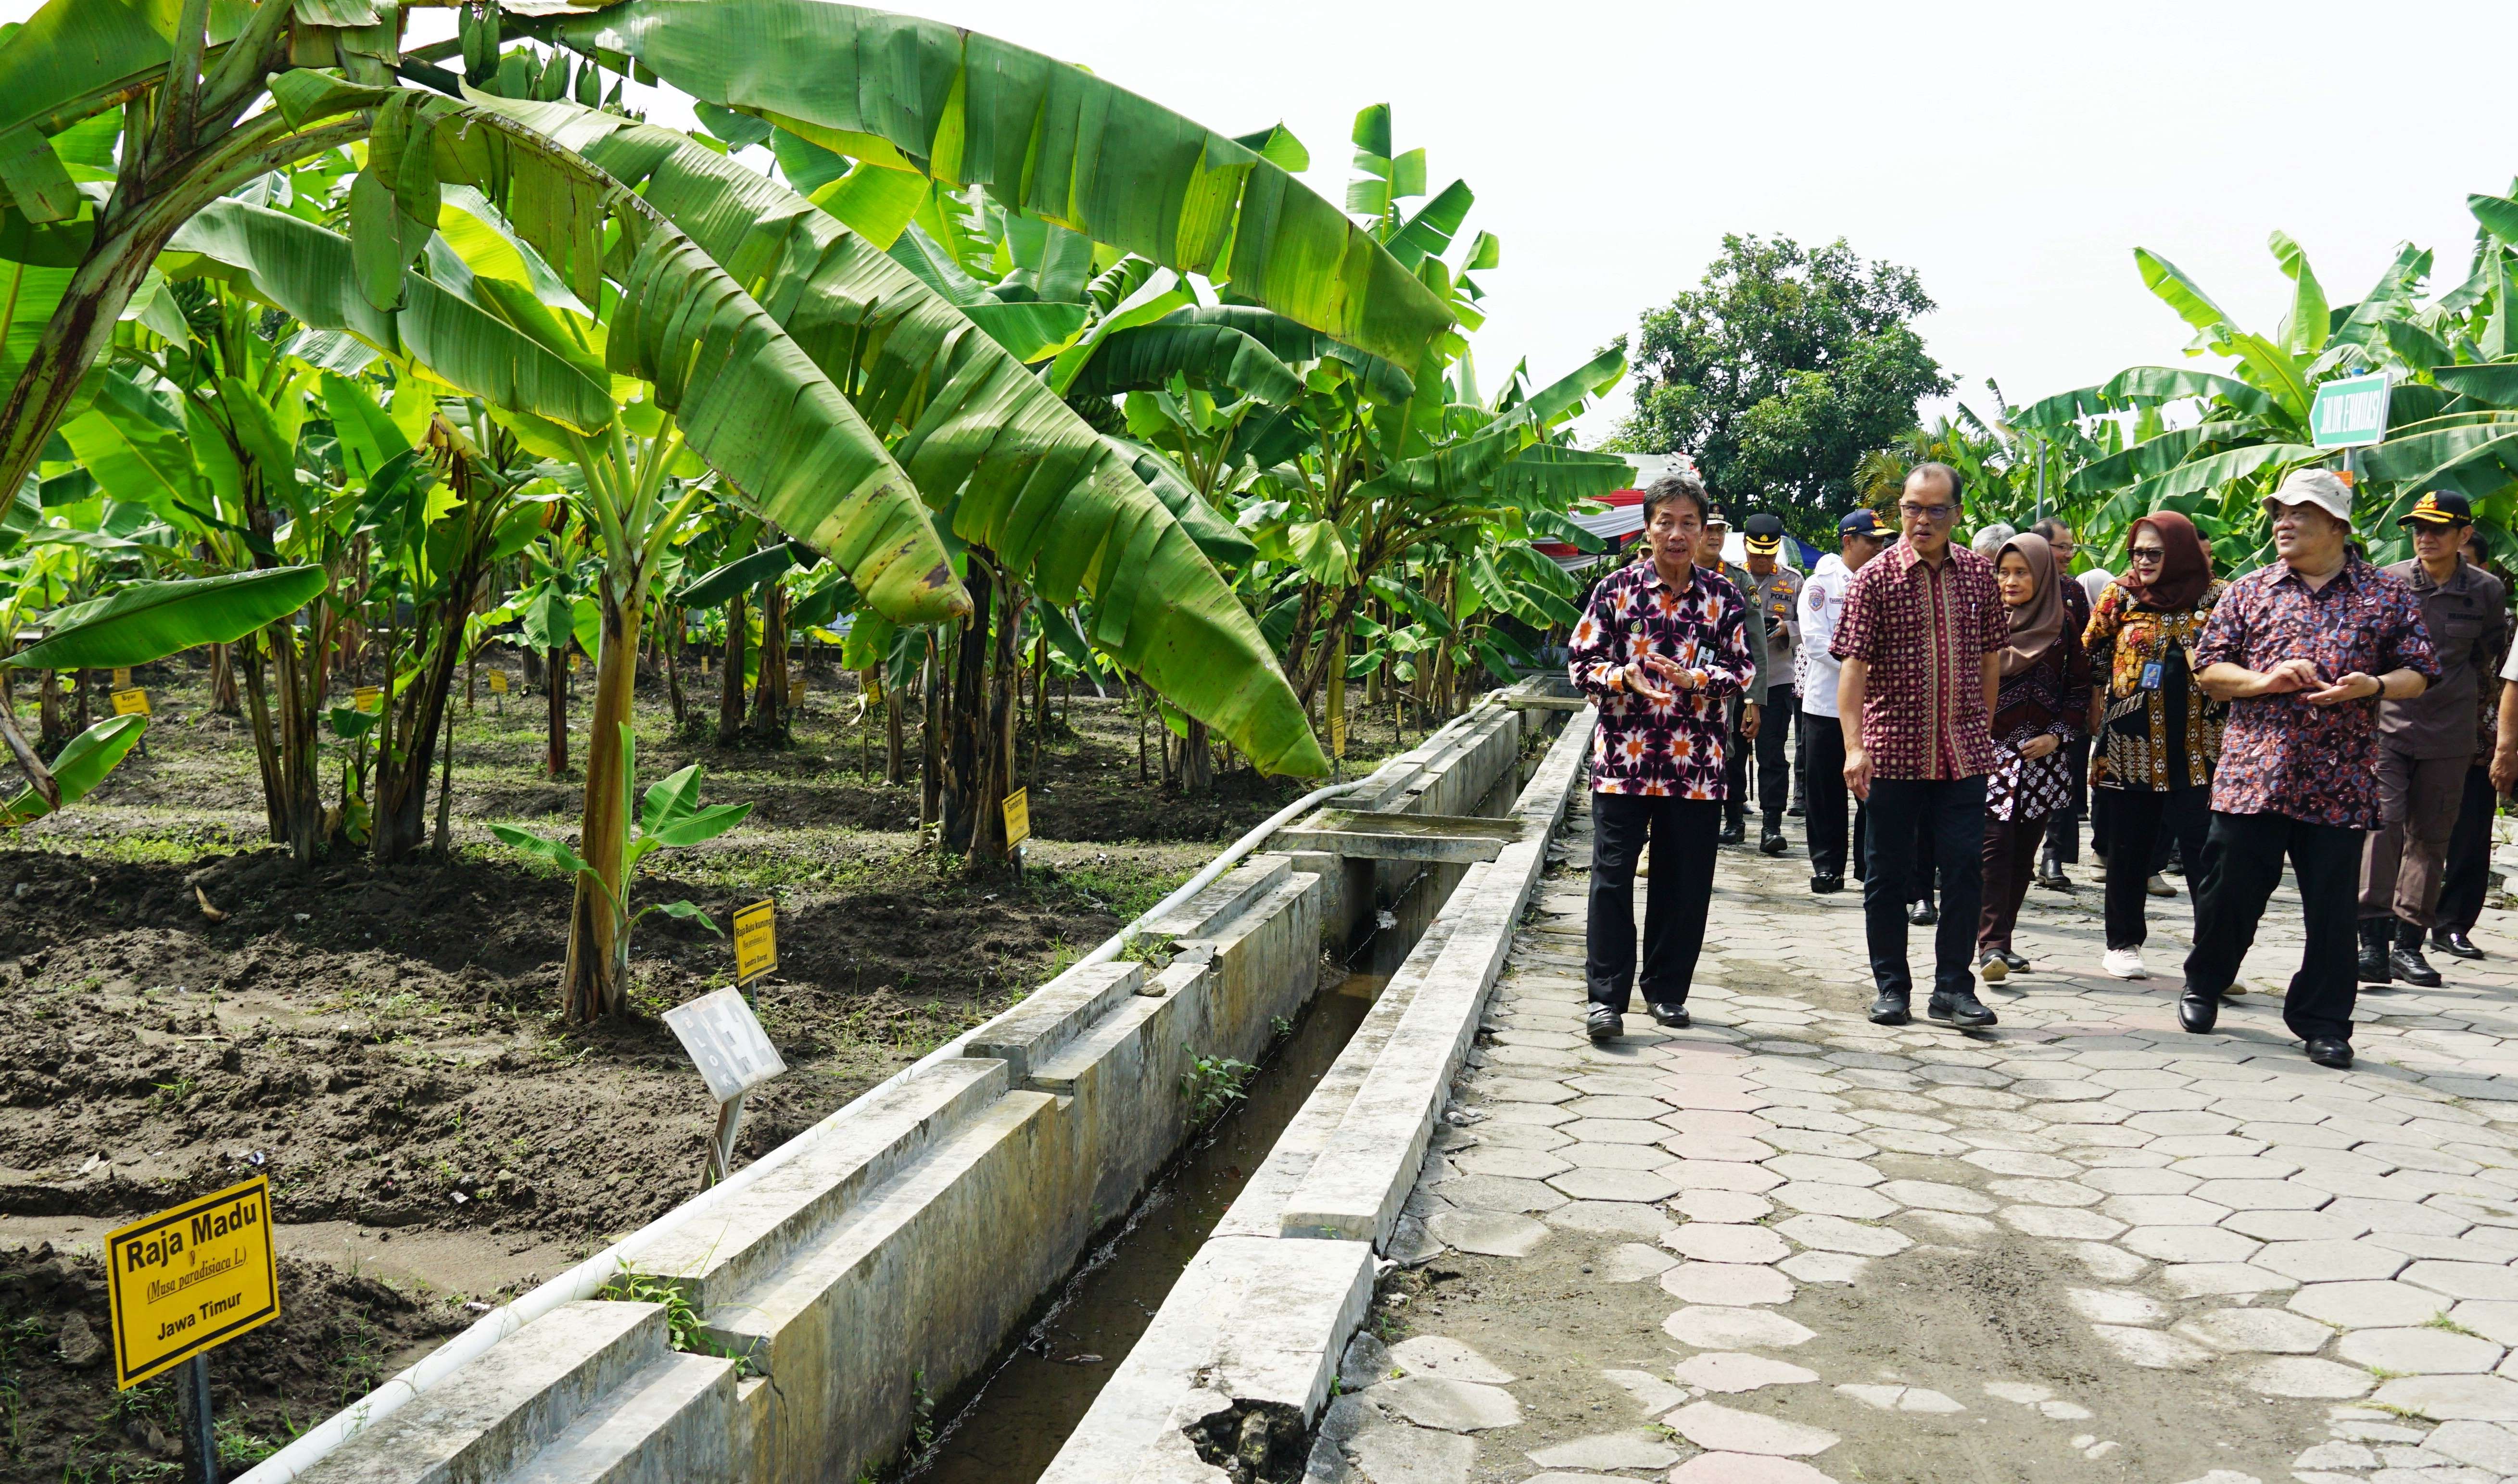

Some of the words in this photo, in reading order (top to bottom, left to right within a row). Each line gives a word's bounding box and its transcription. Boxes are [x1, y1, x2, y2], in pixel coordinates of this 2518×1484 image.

[2320, 395, 2343, 434] JALUR
[2342, 390, 2382, 432] EVAKUASI
[1770, 592, 1792, 602] POLRI
[755, 918, 772, 930] kuning
[757, 954, 768, 962] Barat
[127, 1230, 184, 1273] Raja
[191, 1202, 257, 1246] Madu
[147, 1279, 176, 1303] (Musa
[179, 1258, 231, 1289] paradisiaca
[234, 1246, 247, 1266] L.)
[157, 1313, 196, 1341] Jawa
[199, 1292, 242, 1321] Timur
